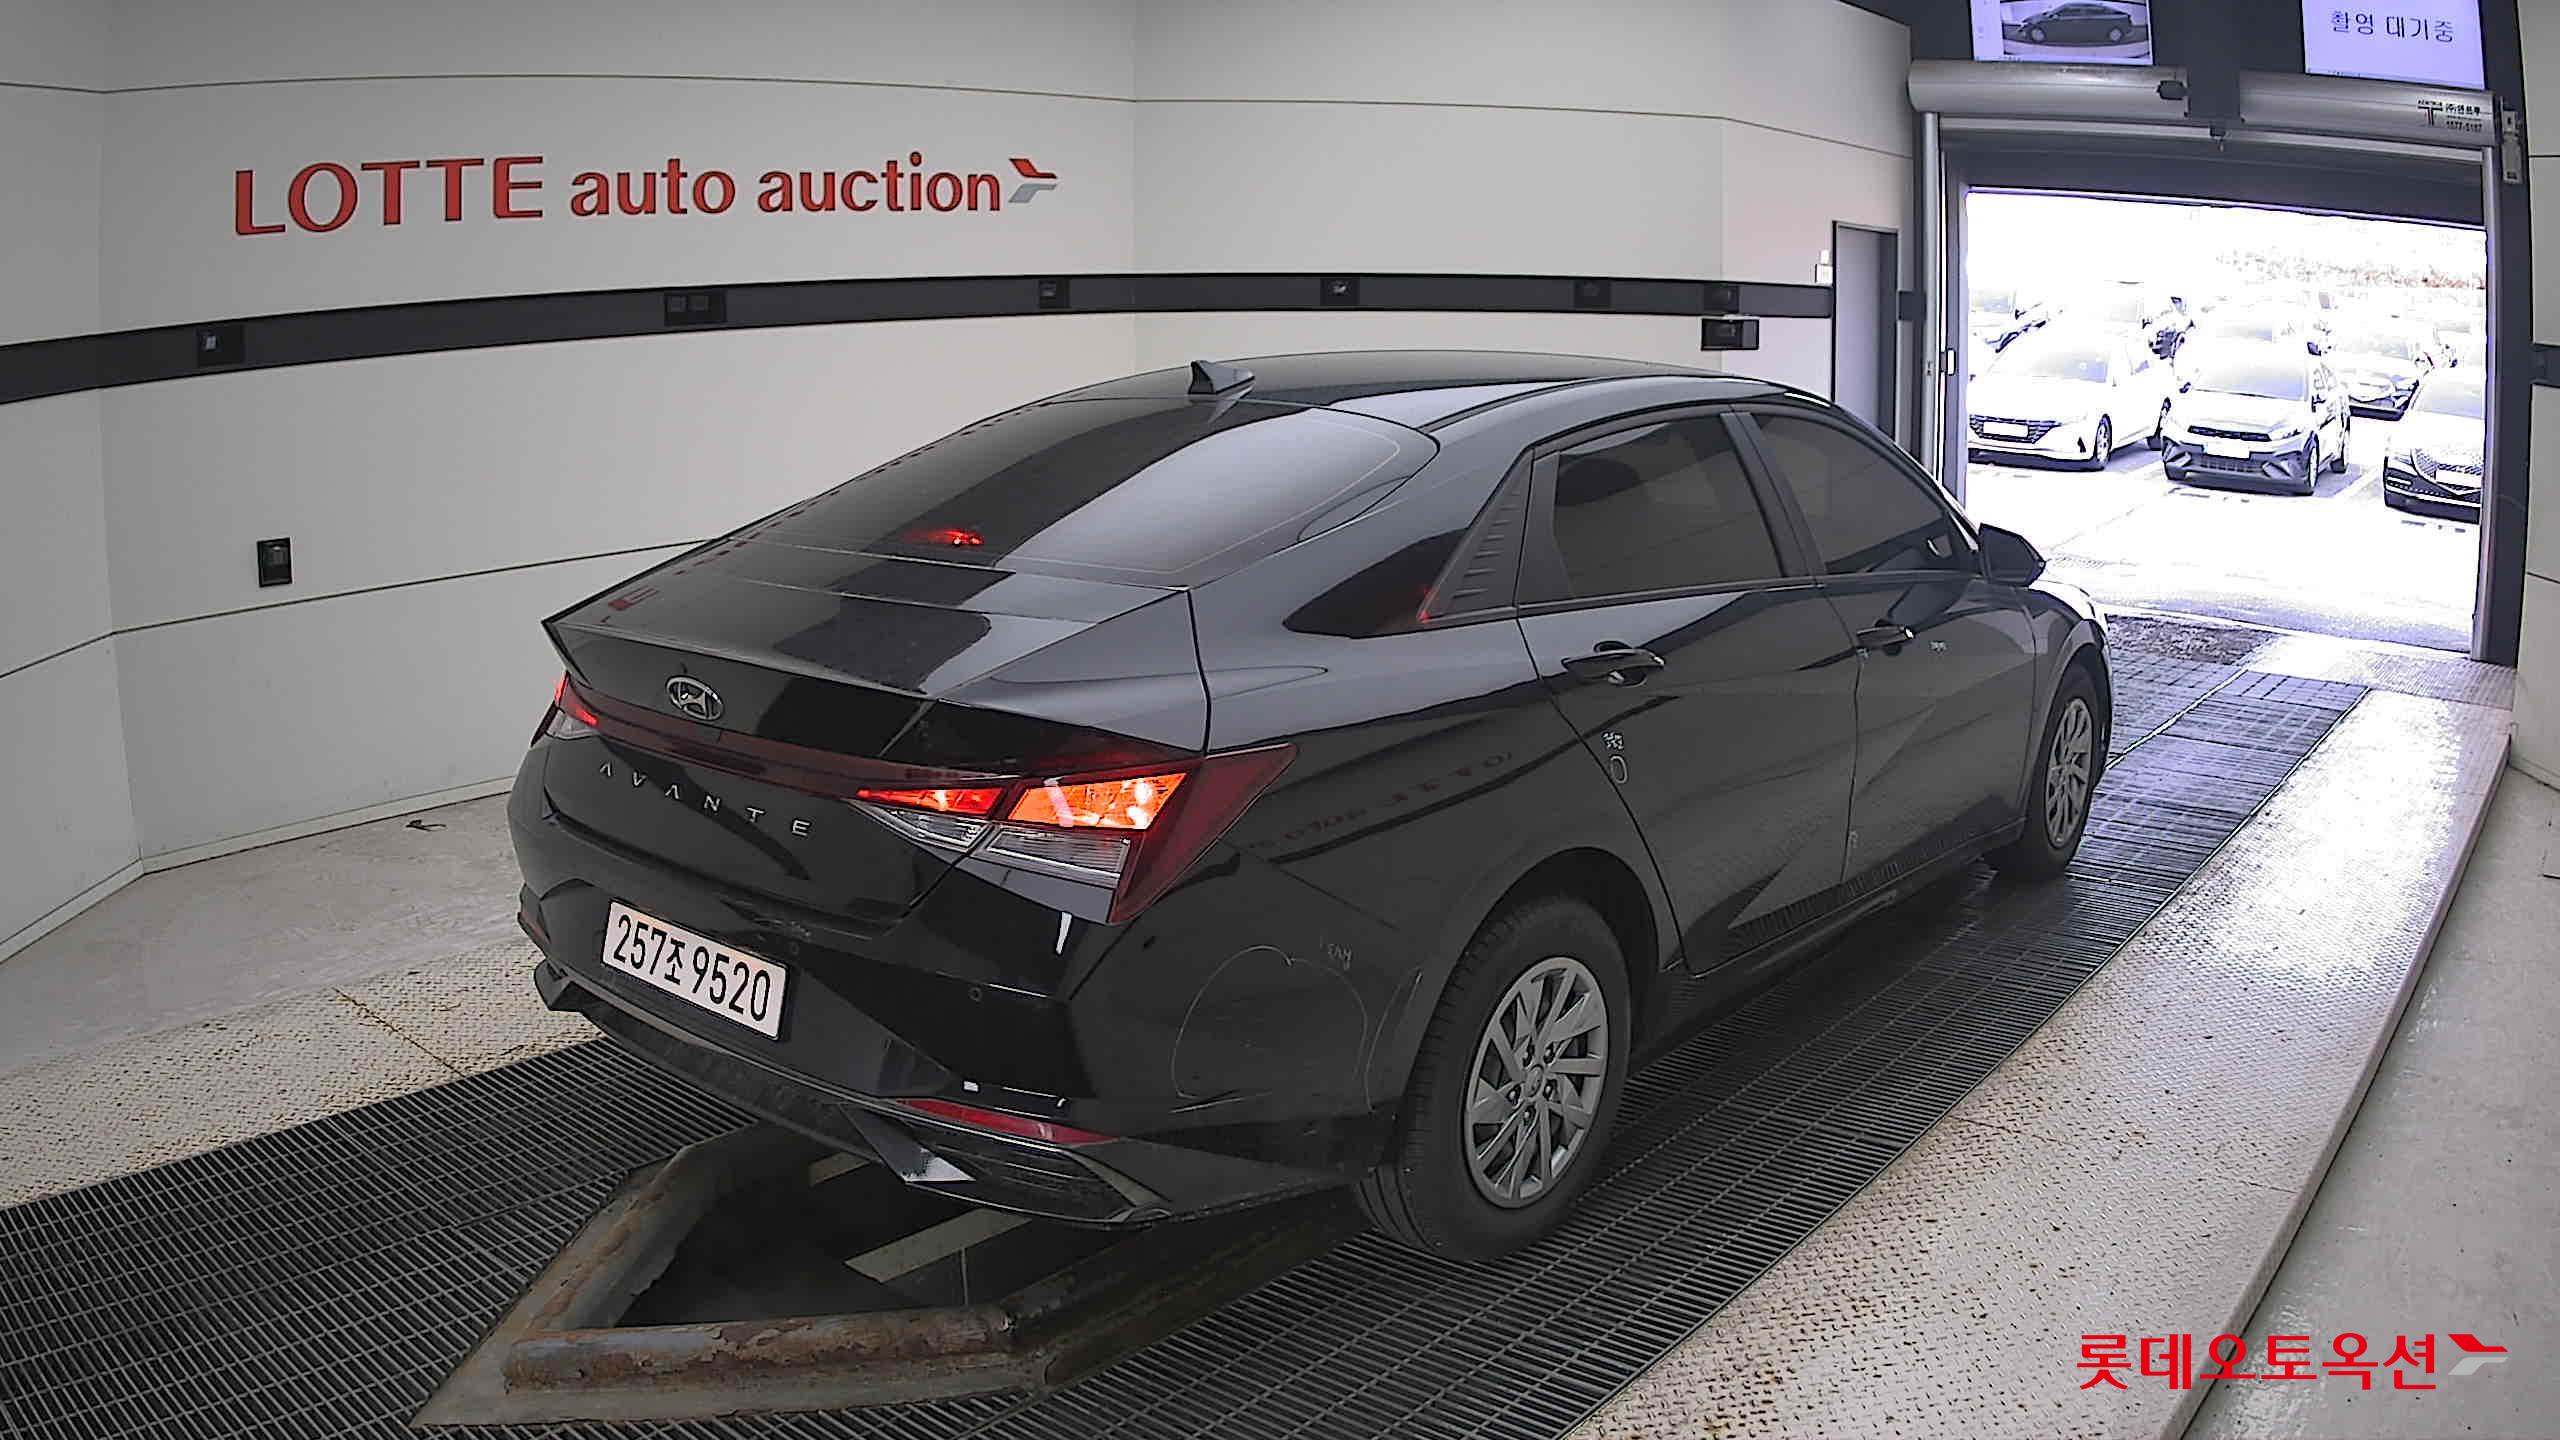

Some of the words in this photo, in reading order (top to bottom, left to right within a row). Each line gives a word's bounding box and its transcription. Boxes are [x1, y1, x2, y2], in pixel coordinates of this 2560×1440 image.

[2331, 10, 2374, 36] 촬영
[2385, 15, 2453, 43] 대기중
[235, 155, 544, 235] LOTTE
[570, 157, 737, 215] auto
[757, 150, 1001, 213] auction
[599, 762, 812, 837] AVANTE
